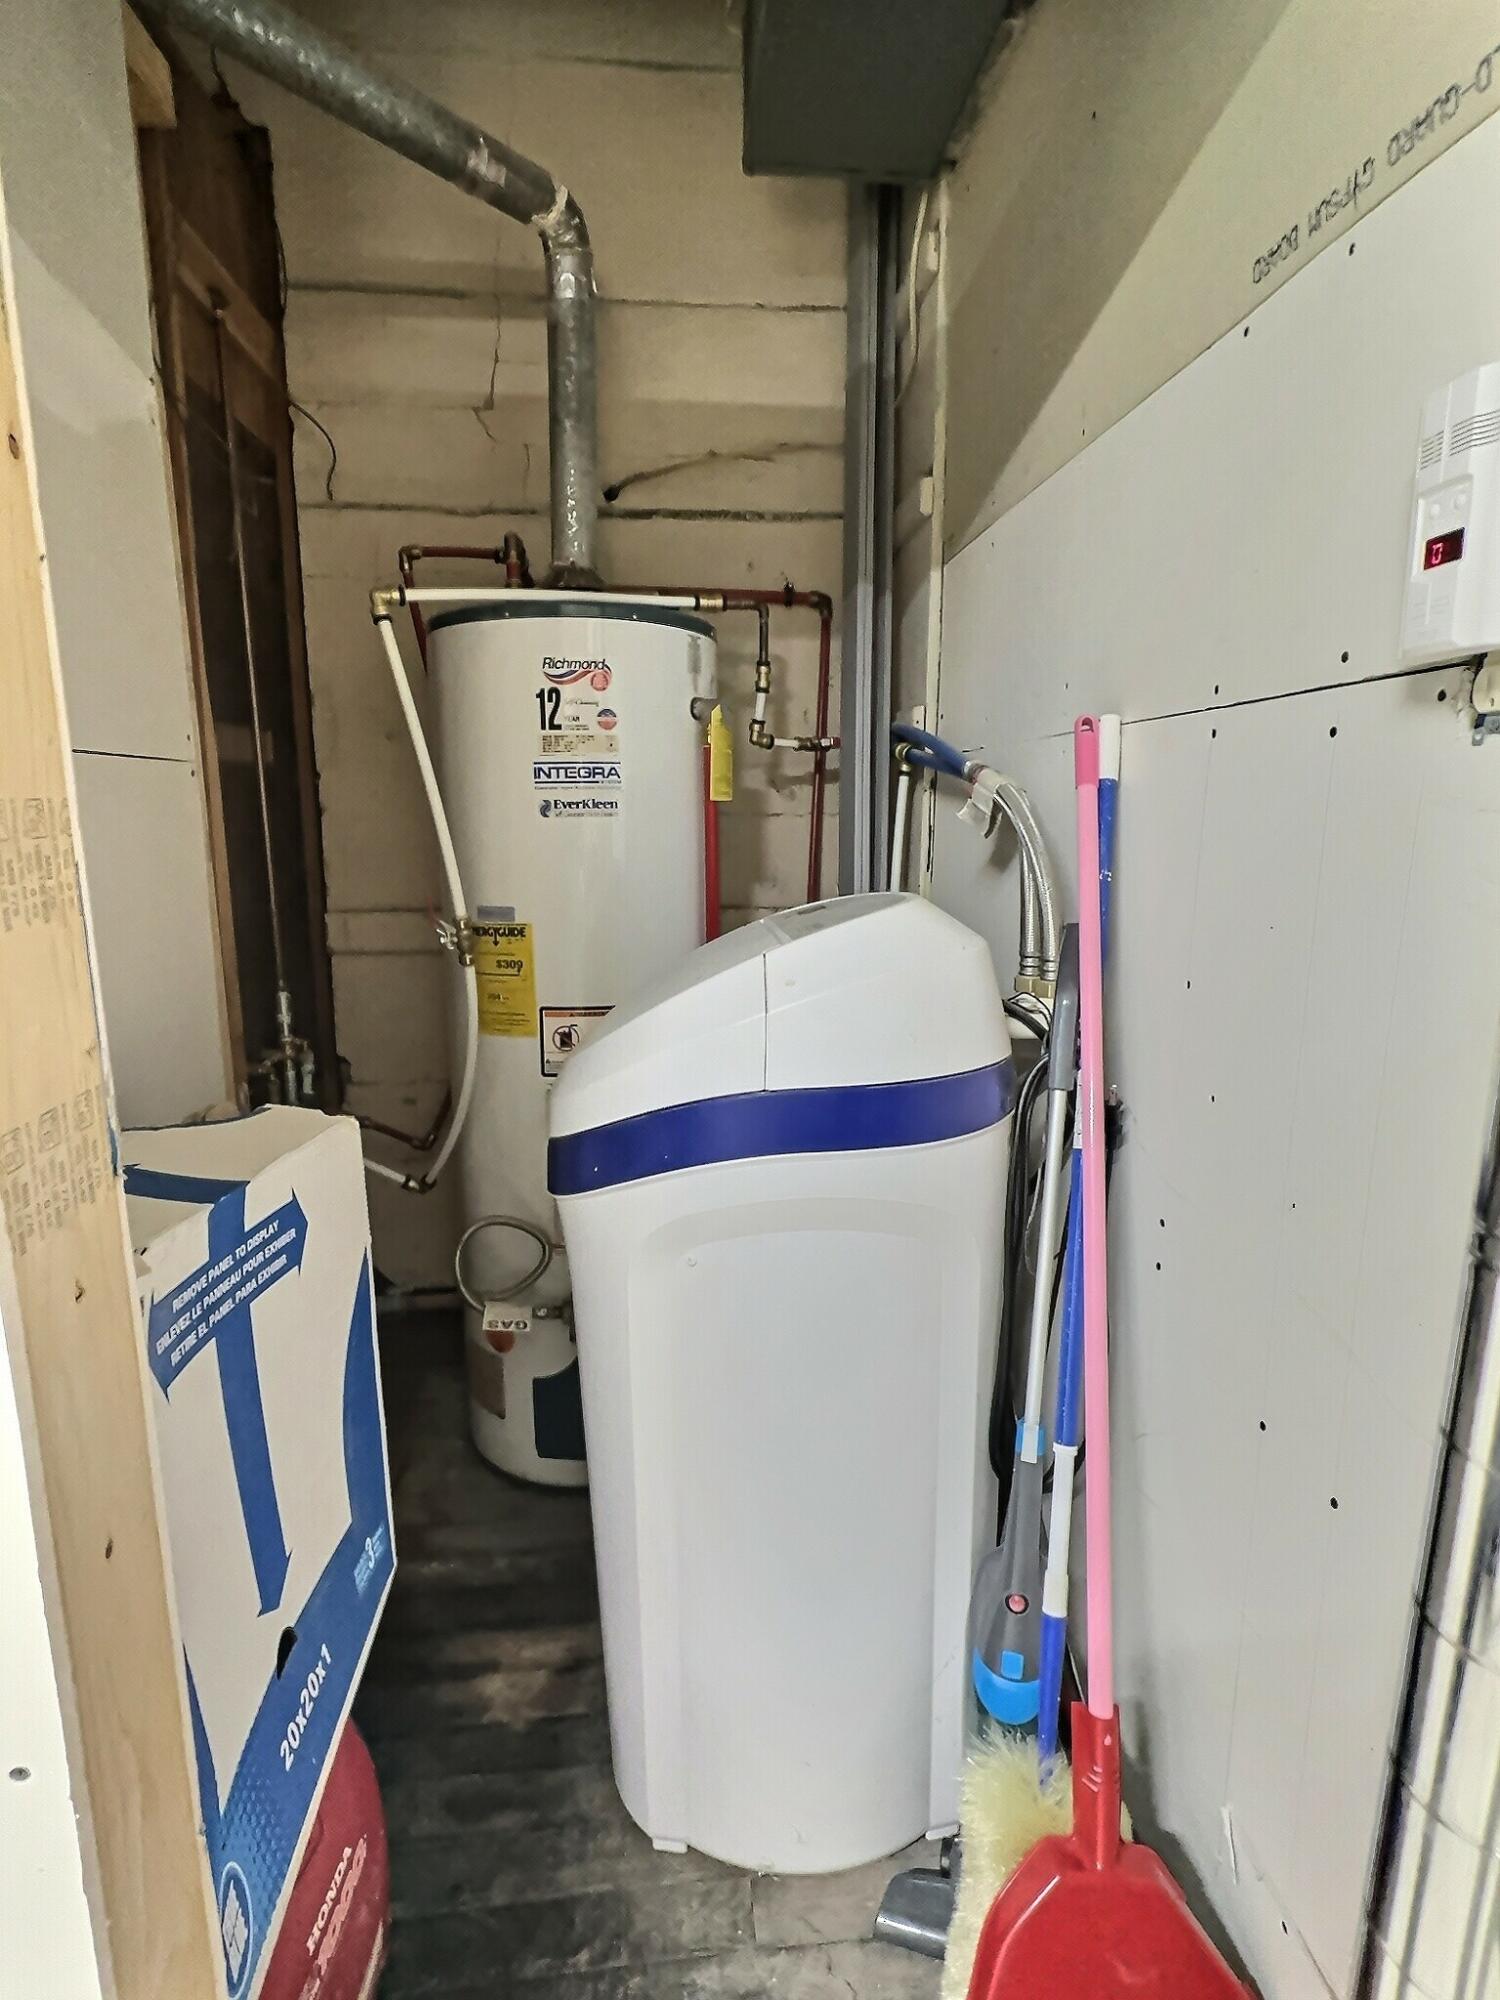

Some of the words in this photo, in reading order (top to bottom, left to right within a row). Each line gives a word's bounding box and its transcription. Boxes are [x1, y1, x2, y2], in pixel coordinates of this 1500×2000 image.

[1307, 156, 1376, 237] GYPSUM
[1252, 223, 1299, 285] BOARD
[542, 656, 606, 670] Richmond
[535, 686, 563, 731] 12
[533, 766, 621, 780] INTEGRA
[553, 798, 619, 810] EverKleen
[172, 1273, 208, 1314] REMOVE
[208, 1254, 235, 1282] PANEL
[234, 1244, 246, 1260] TO
[246, 1219, 279, 1252] DISPLAY
[155, 1311, 192, 1356] ENLEVEZ
[191, 1301, 203, 1320] LE
[203, 1268, 242, 1310] PANNEAU
[242, 1251, 265, 1276] POUR
[170, 1331, 198, 1367] RETIRE
[197, 1320, 210, 1339] EL
[208, 1297, 236, 1329] PANEL
[235, 1278, 258, 1305] PARA
[486, 1319, 528, 1330] GAS
[279, 1642, 332, 1773] 20x20x1
[306, 1846, 353, 1957] HONDA
